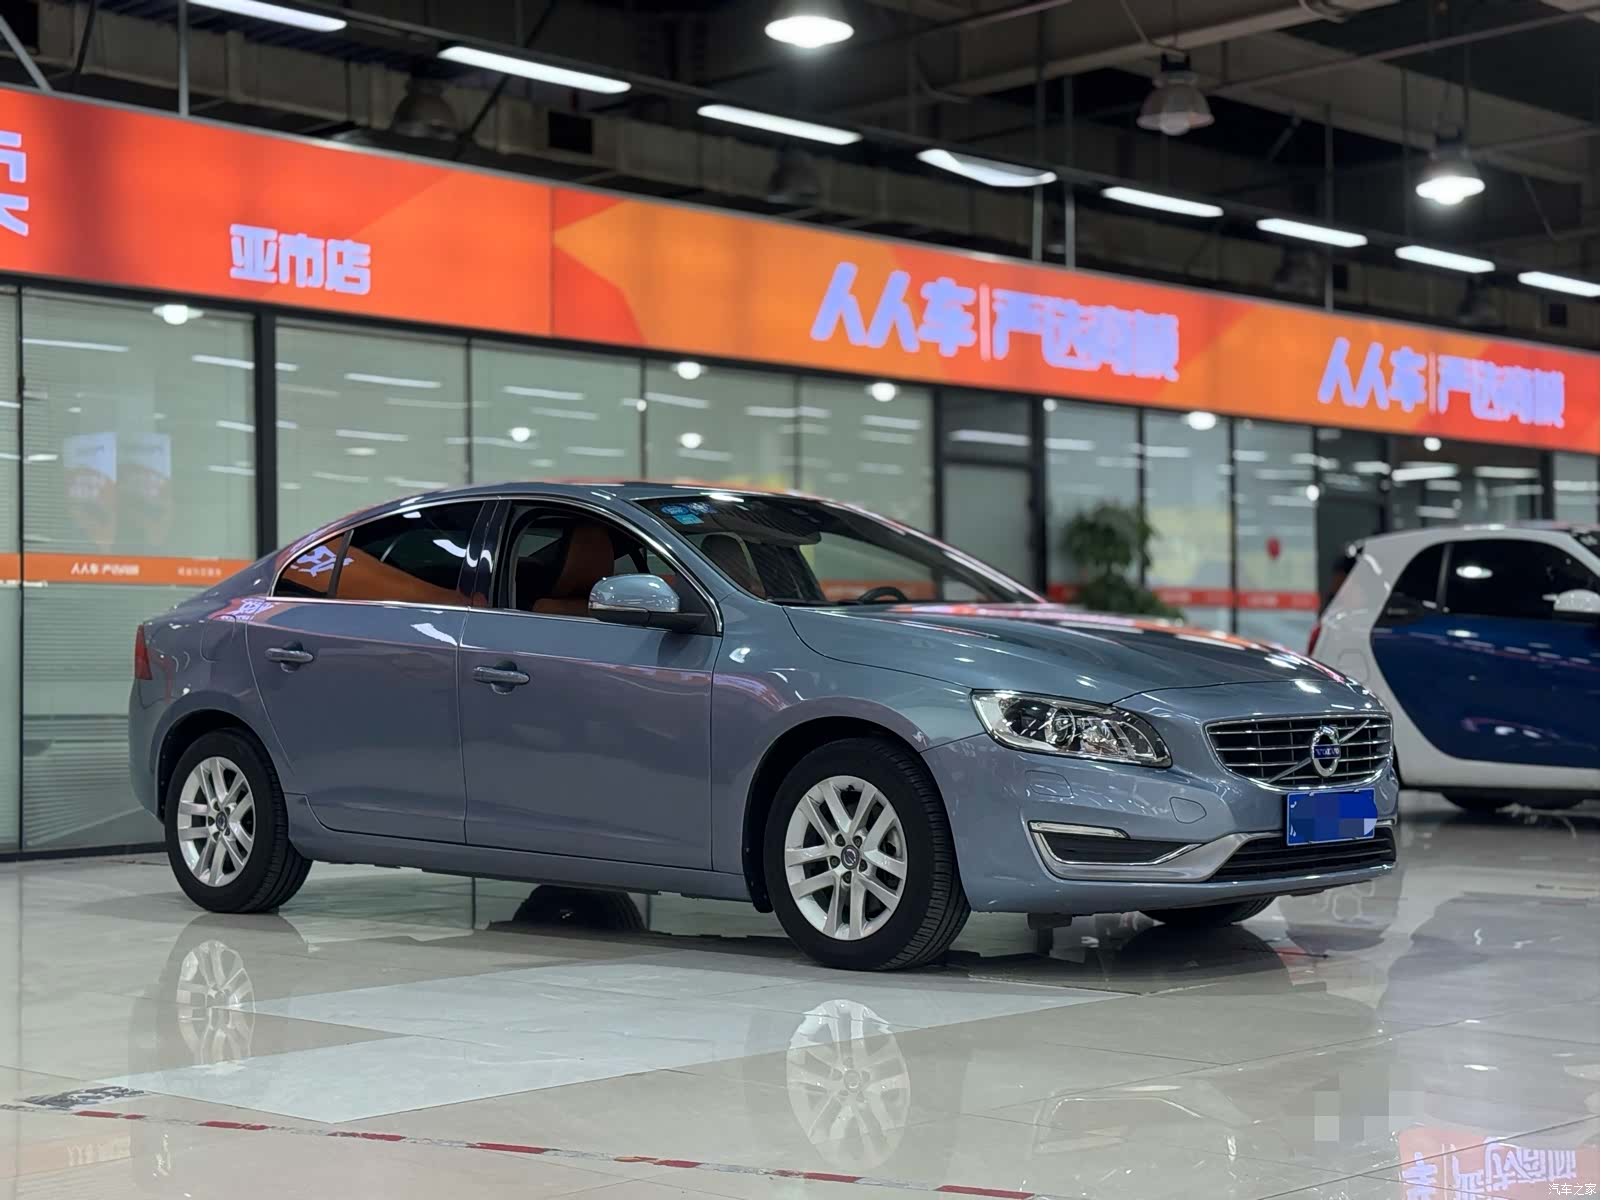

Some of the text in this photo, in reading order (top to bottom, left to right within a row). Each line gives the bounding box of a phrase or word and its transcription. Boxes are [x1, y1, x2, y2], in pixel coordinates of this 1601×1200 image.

[229, 223, 371, 296] 亚市店
[810, 261, 978, 358] 人人车
[1317, 336, 1427, 412] 人人车
[1315, 748, 1340, 756] VOLVO
